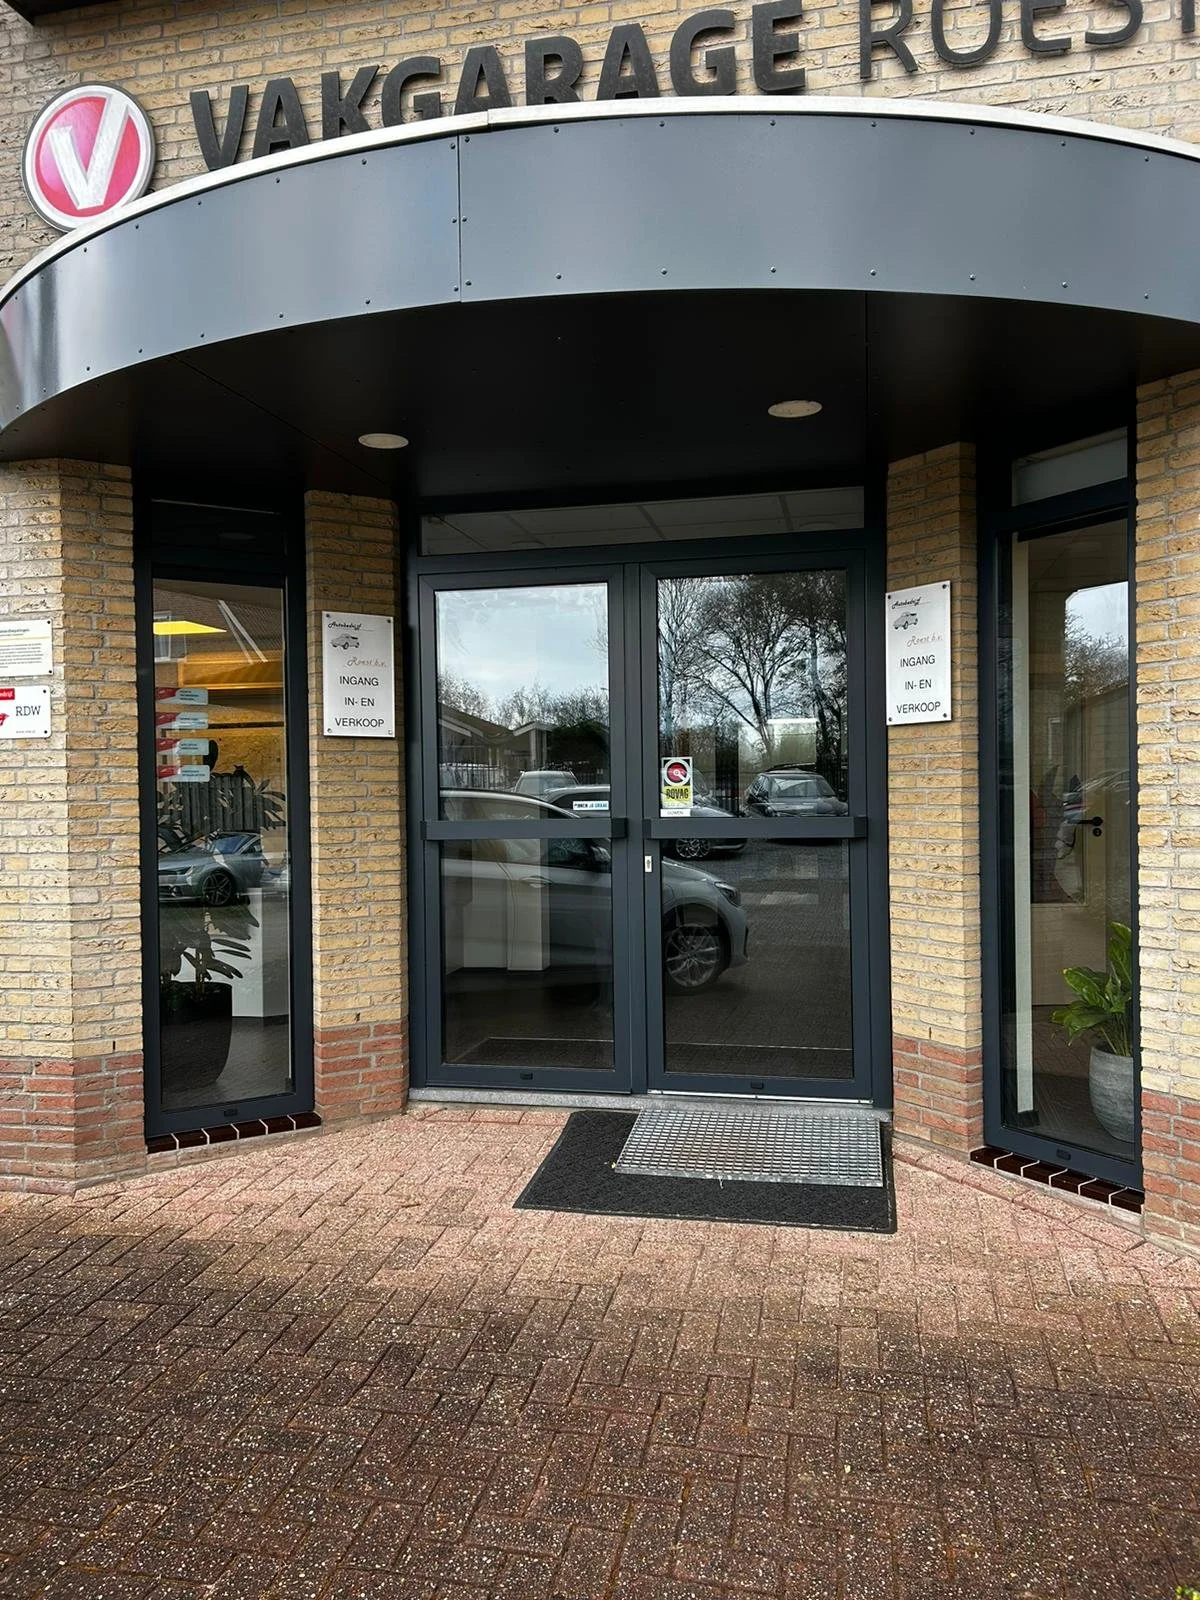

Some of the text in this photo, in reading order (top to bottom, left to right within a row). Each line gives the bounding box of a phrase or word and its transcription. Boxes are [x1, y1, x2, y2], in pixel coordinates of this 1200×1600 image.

[190, 0, 806, 171] VAKGARAGE
[48, 92, 130, 209] V
[900, 655, 936, 667] INGANG
[339, 675, 379, 687] INGANG
[904, 680, 932, 690] IN- EN
[344, 697, 375, 707] IN- EN
[896, 702, 941, 714] VERKOOP
[15, 705, 41, 717] RDW
[334, 717, 385, 728] VERKOOP
[666, 788, 689, 800] BOVAG
